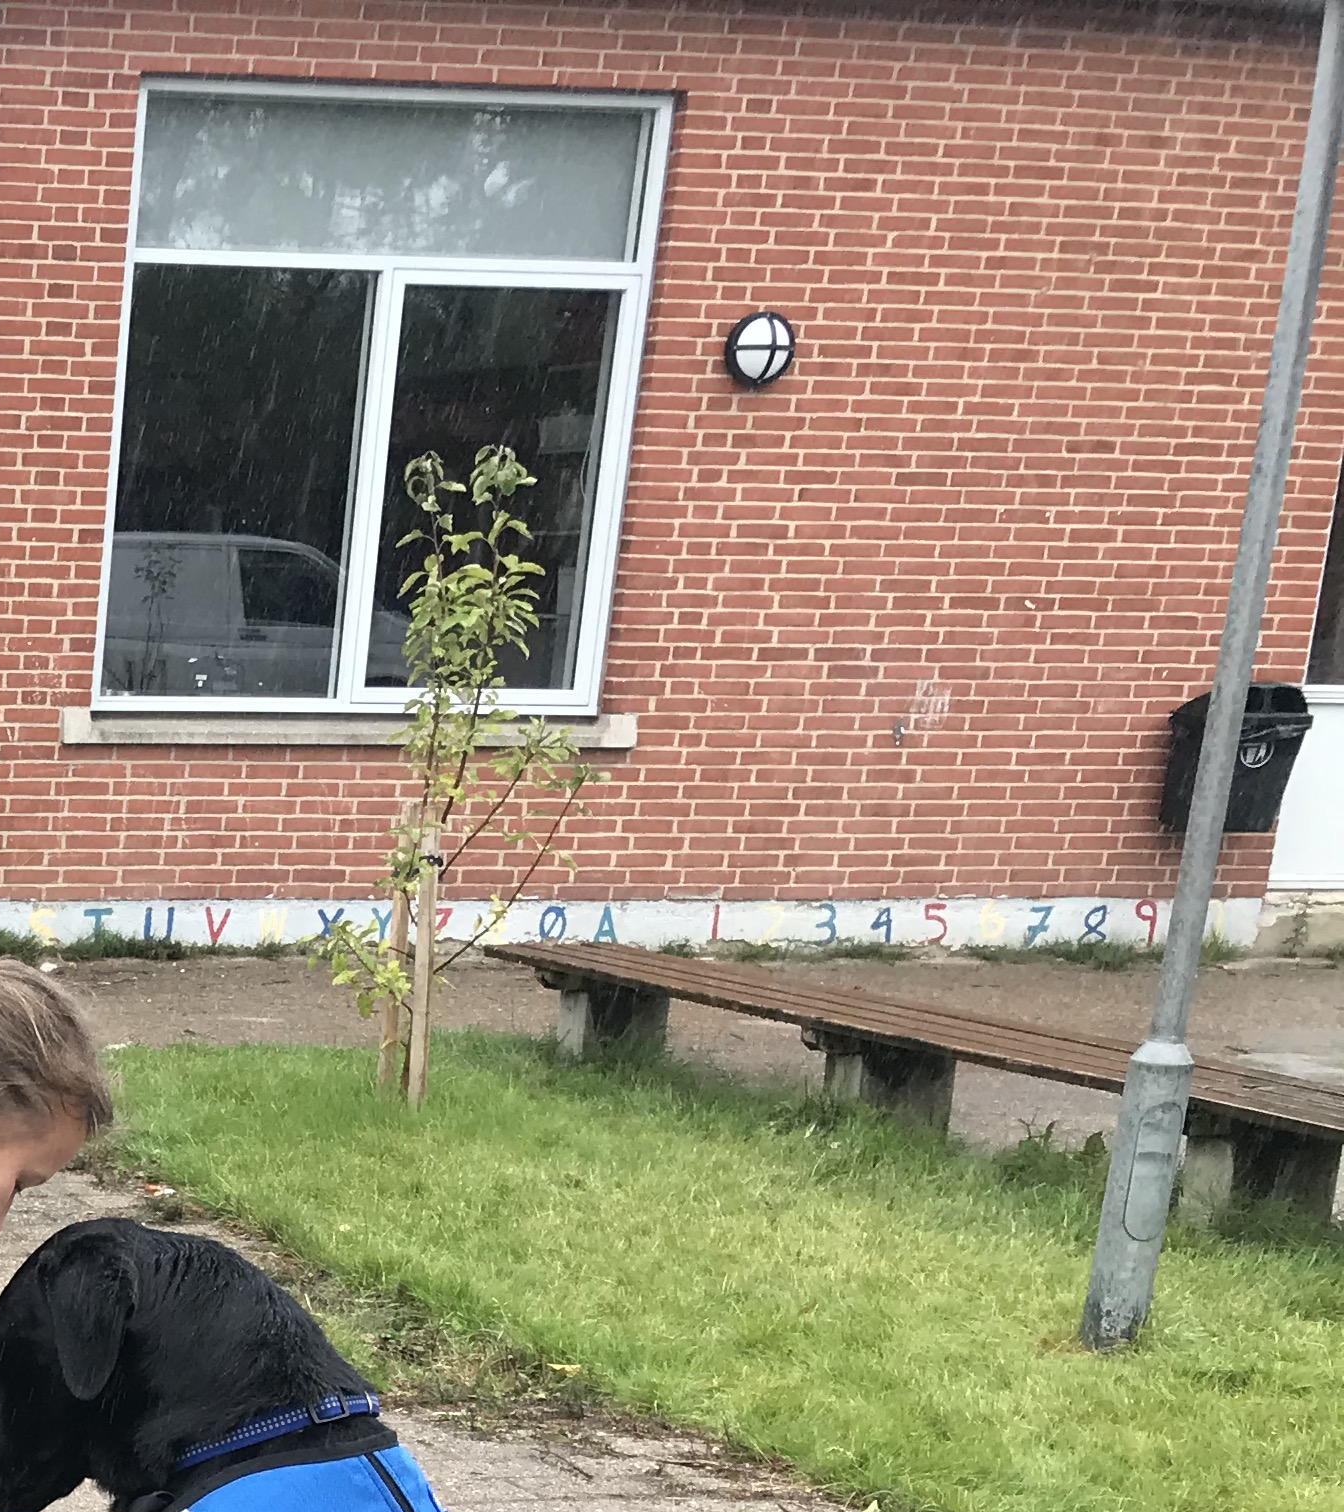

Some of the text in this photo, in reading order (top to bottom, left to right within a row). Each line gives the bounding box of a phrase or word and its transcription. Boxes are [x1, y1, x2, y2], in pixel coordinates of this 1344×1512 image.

[29, 909, 57, 946] S
[83, 908, 113, 943] T
[144, 907, 175, 941] U
[205, 907, 232, 945] V
[317, 907, 345, 937] X
[371, 907, 393, 940] Y
[815, 903, 837, 947] 3
[870, 907, 892, 944] 4
[919, 903, 948, 944] 5
[980, 900, 1006, 939] 6
[1026, 905, 1055, 947] 7
[1078, 904, 1108, 944] 8
[1135, 899, 1158, 948] 9
